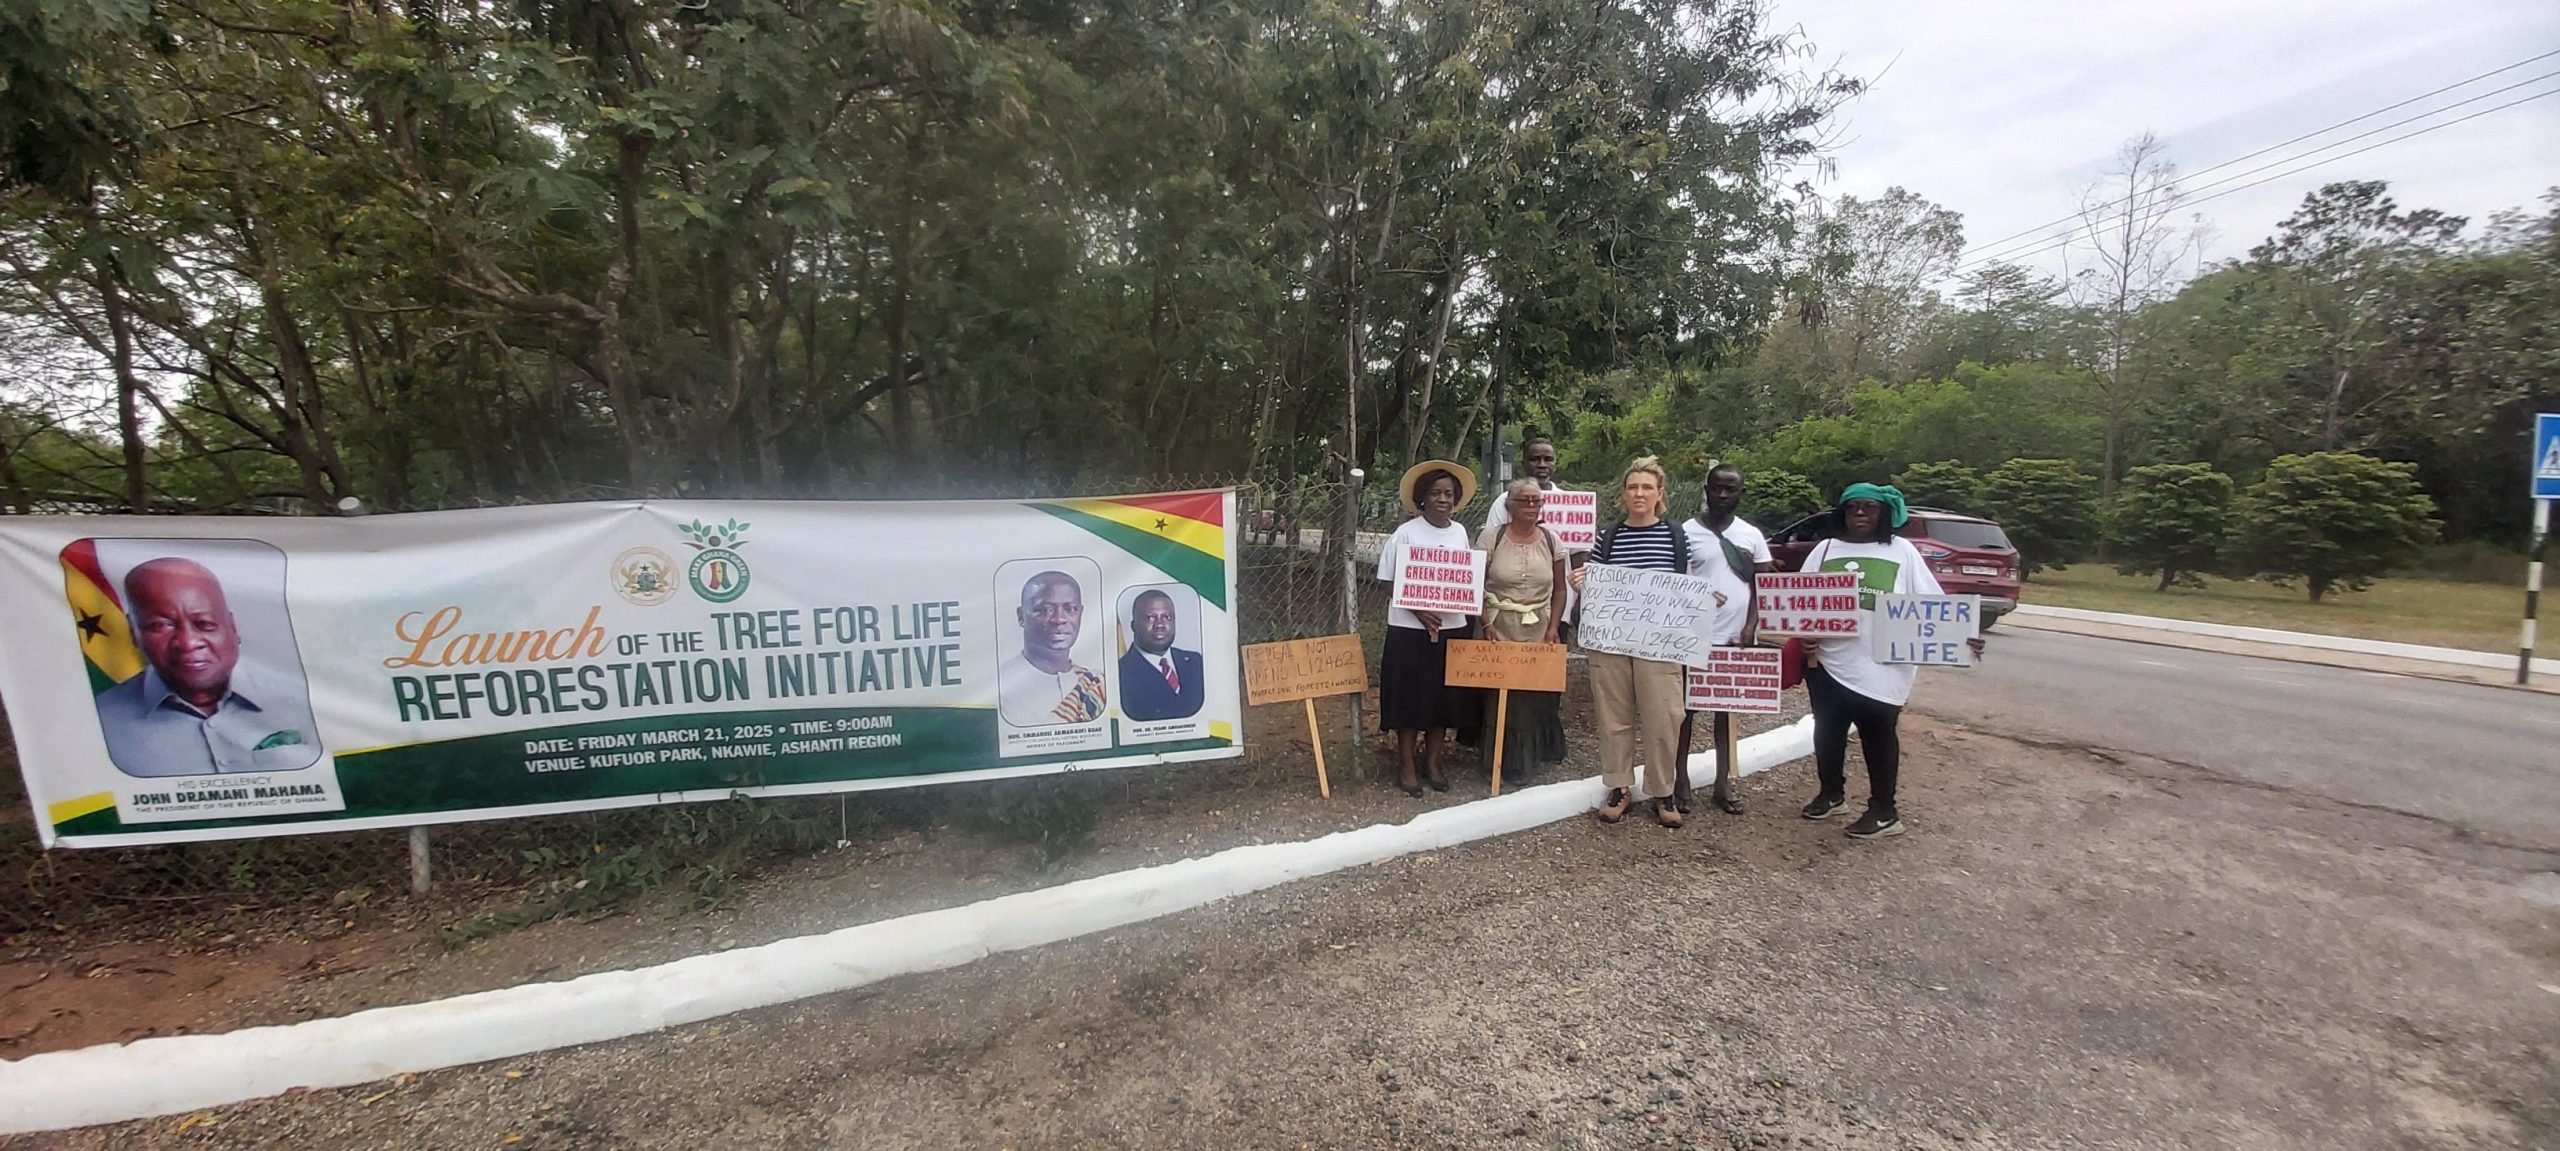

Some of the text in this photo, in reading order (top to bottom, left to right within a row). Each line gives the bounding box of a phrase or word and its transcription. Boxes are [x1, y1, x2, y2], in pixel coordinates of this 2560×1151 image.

[1542, 494, 1594, 505] HDRAW
[1566, 511, 1594, 525] AND
[1560, 530, 1594, 543] 462
[1410, 546, 1472, 566] WE NEED OUR
[1406, 565, 1473, 584] GREEN SPACES
[1584, 564, 1713, 595] PRESIDENT MAHAMA:
[1757, 575, 1856, 589] WITHDRAW
[1402, 583, 1475, 603] ACROSS GHANA
[1584, 585, 1708, 612] YOU SAID YOU WILL
[1787, 595, 1819, 611] 144
[1821, 595, 1857, 611] AND
[1886, 600, 1970, 622] WATER
[1662, 612, 1700, 628] NOT
[1799, 617, 1859, 633] 2462
[383, 601, 961, 669] Launch OF THE TREE FOR LIFE
[1580, 623, 1622, 641] AMEND
[1918, 622, 1937, 637] IS
[1306, 641, 1329, 656] NOT
[1731, 651, 1778, 662] SPACES
[1891, 641, 1958, 662] LIFE
[1508, 656, 1537, 665] OUR
[392, 644, 963, 722] REFORESTATION INITIATIVE
[1688, 674, 1704, 685] TO
[524, 716, 893, 754] DATE: FRIDAY MARCH 21, 2025 TIME: 9:00AM
[525, 734, 902, 773] VENUE: KUFUOR PARK, NKAWIE, ASHANTI REGION
[178, 776, 273, 789] HIS EXCELLENCY
[133, 784, 325, 806] JOHN DRAMANI MAHAMA
